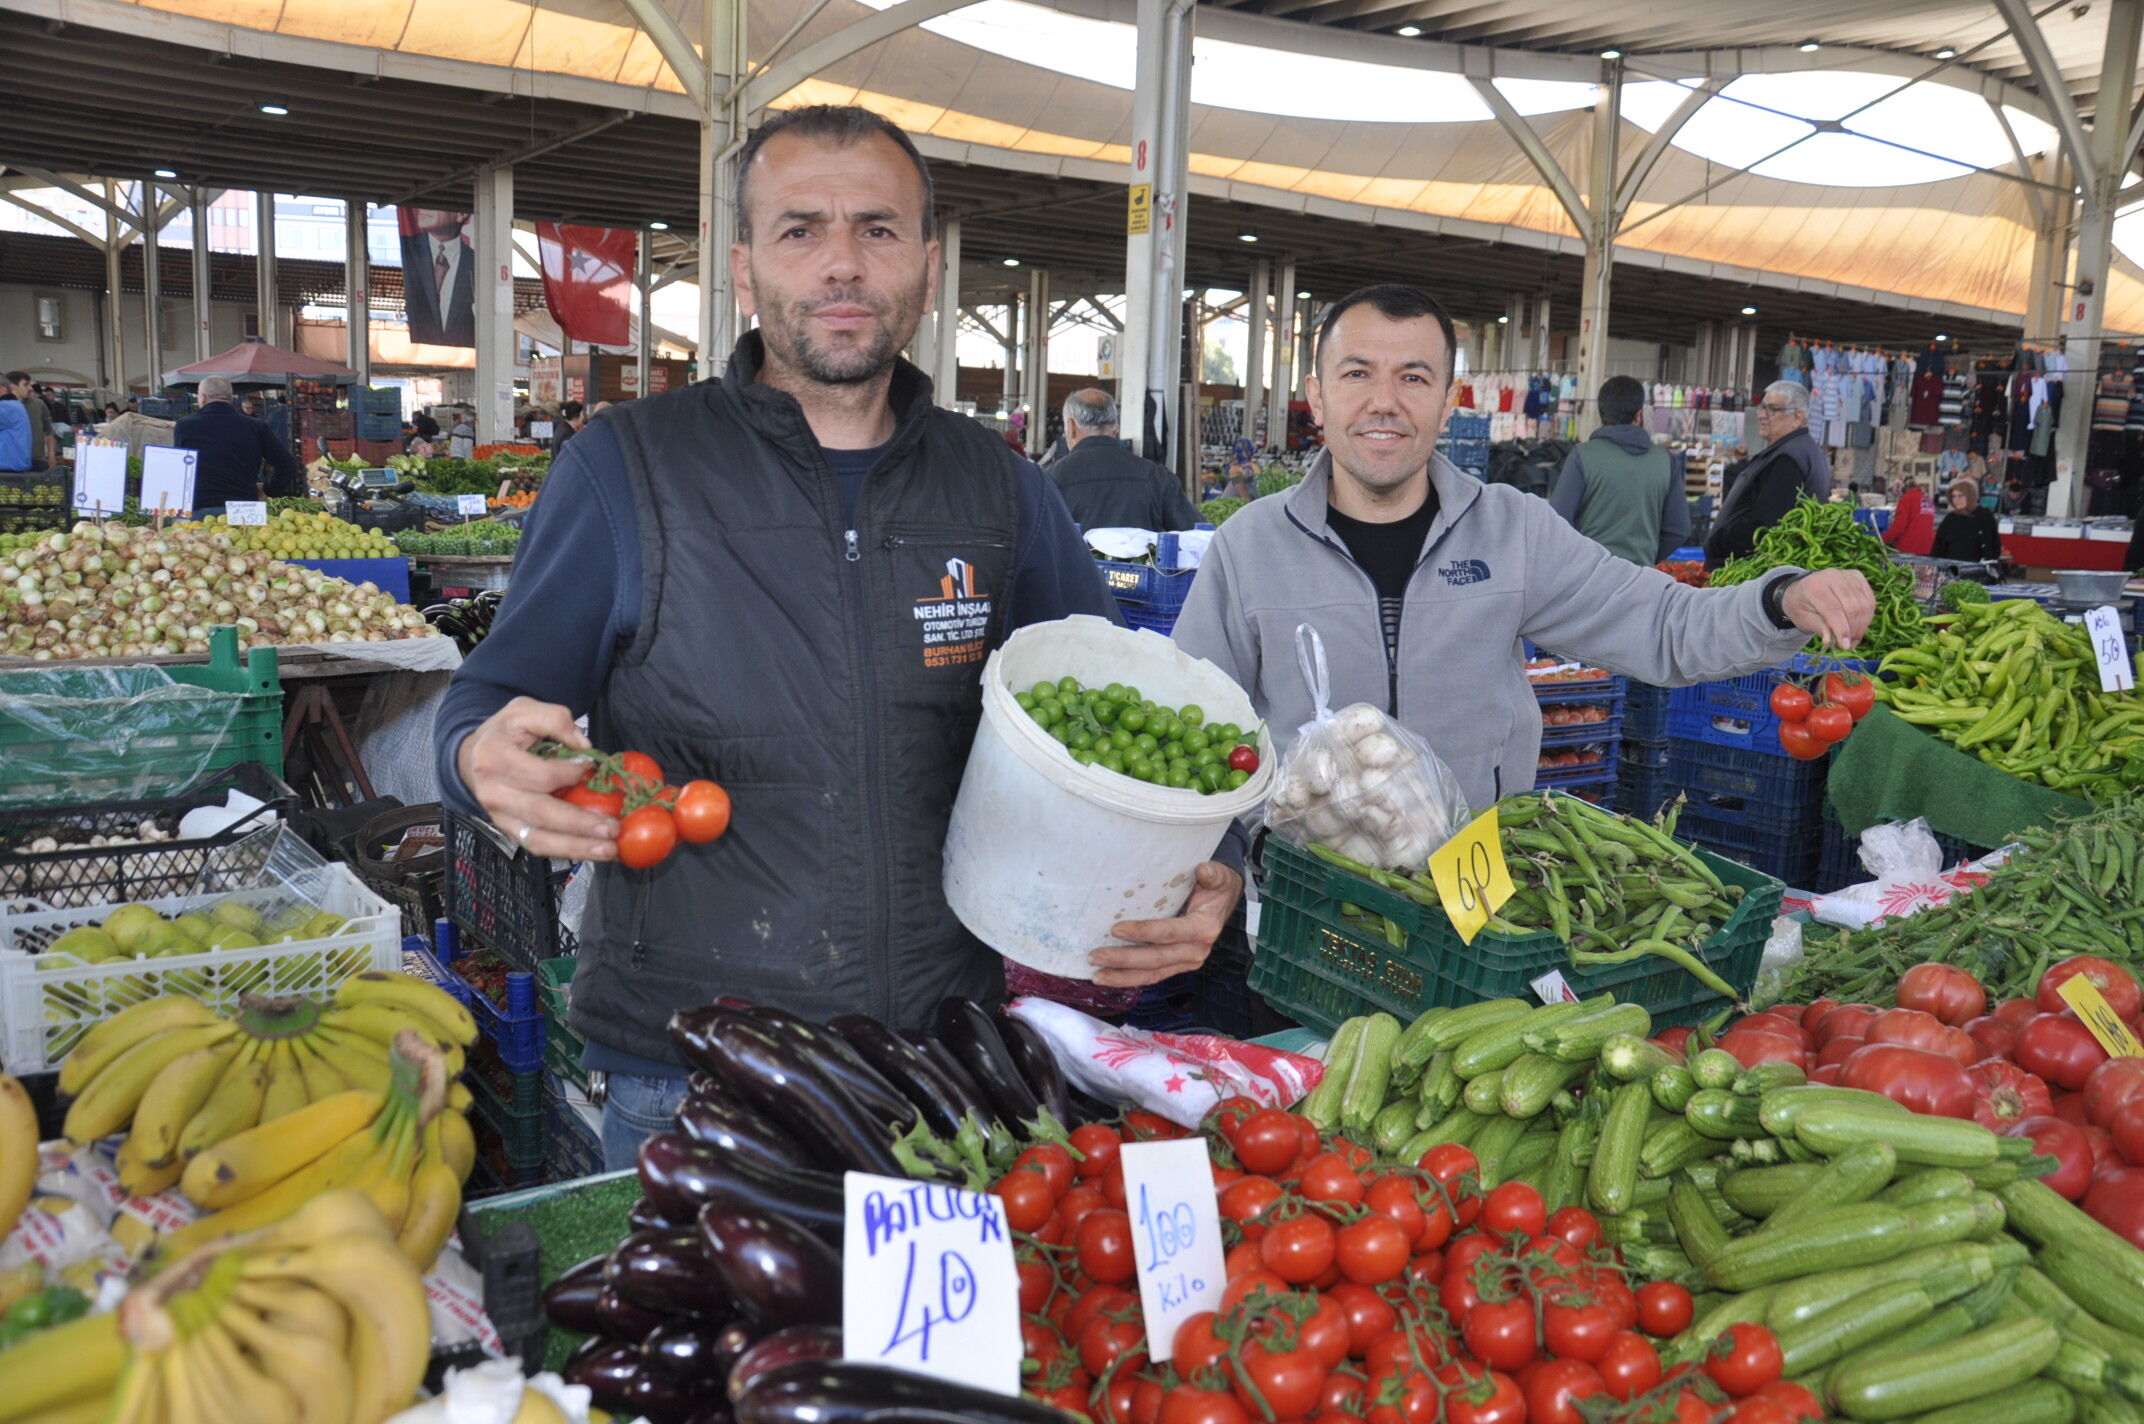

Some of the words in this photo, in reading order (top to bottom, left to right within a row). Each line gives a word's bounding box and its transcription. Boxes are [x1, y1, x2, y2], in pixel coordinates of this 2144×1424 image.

[1137, 139, 1147, 171] 8
[499, 264, 509, 281] 6
[356, 290, 364, 304] 5
[2075, 302, 2086, 321] 8
[1583, 318, 1591, 333] 7
[1450, 559, 1470, 569] THE
[1438, 567, 1471, 577] NORTH
[1447, 575, 1472, 586] FACE
[914, 603, 955, 619] NEHİR
[924, 620, 964, 631] OTOMOTİV
[924, 646, 965, 656] BURHAN
[2102, 633, 2120, 665] 50
[924, 657, 949, 667] 0531
[1456, 840, 1491, 911] 60
[1139, 1182, 1196, 1272] 100
[880, 1240, 977, 1362] 40
